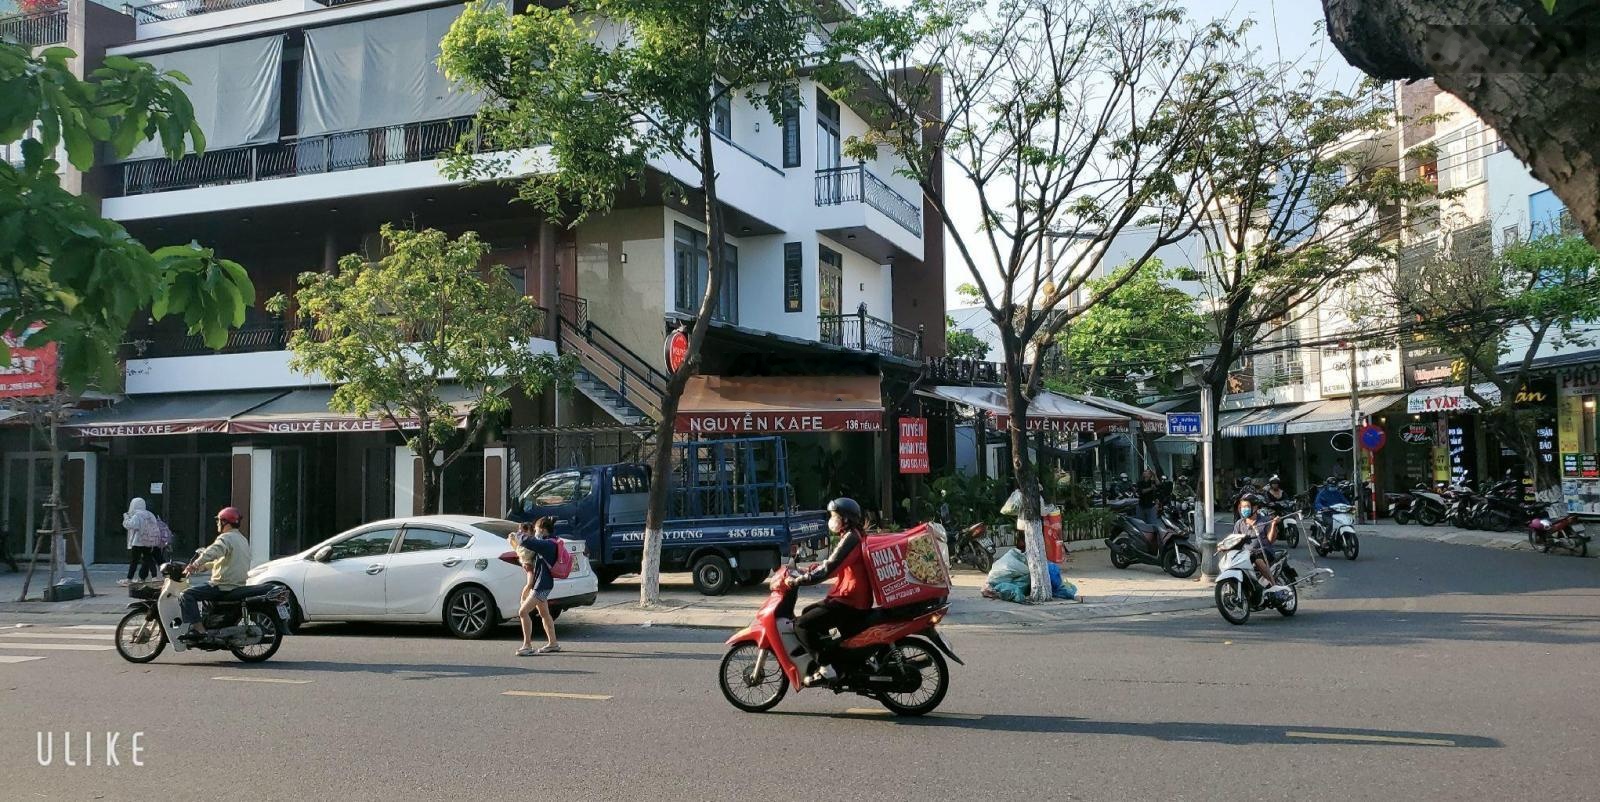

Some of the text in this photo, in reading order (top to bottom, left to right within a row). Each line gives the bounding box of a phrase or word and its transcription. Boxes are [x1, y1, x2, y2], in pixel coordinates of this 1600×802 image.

[268, 419, 333, 432] NGUYỄN
[338, 421, 381, 431] KAFE
[690, 411, 768, 431] NGUYỄN
[774, 416, 823, 430] KAFE
[845, 419, 859, 430] 136
[873, 422, 880, 430] LA
[1006, 416, 1060, 431] NUYỄN
[1062, 421, 1095, 432] KAFE
[81, 425, 171, 437] NGUYỄN KAFE
[751, 528, 775, 538] 6551
[871, 544, 902, 567] MUA 1
[876, 561, 902, 582] ĐƯỢC
